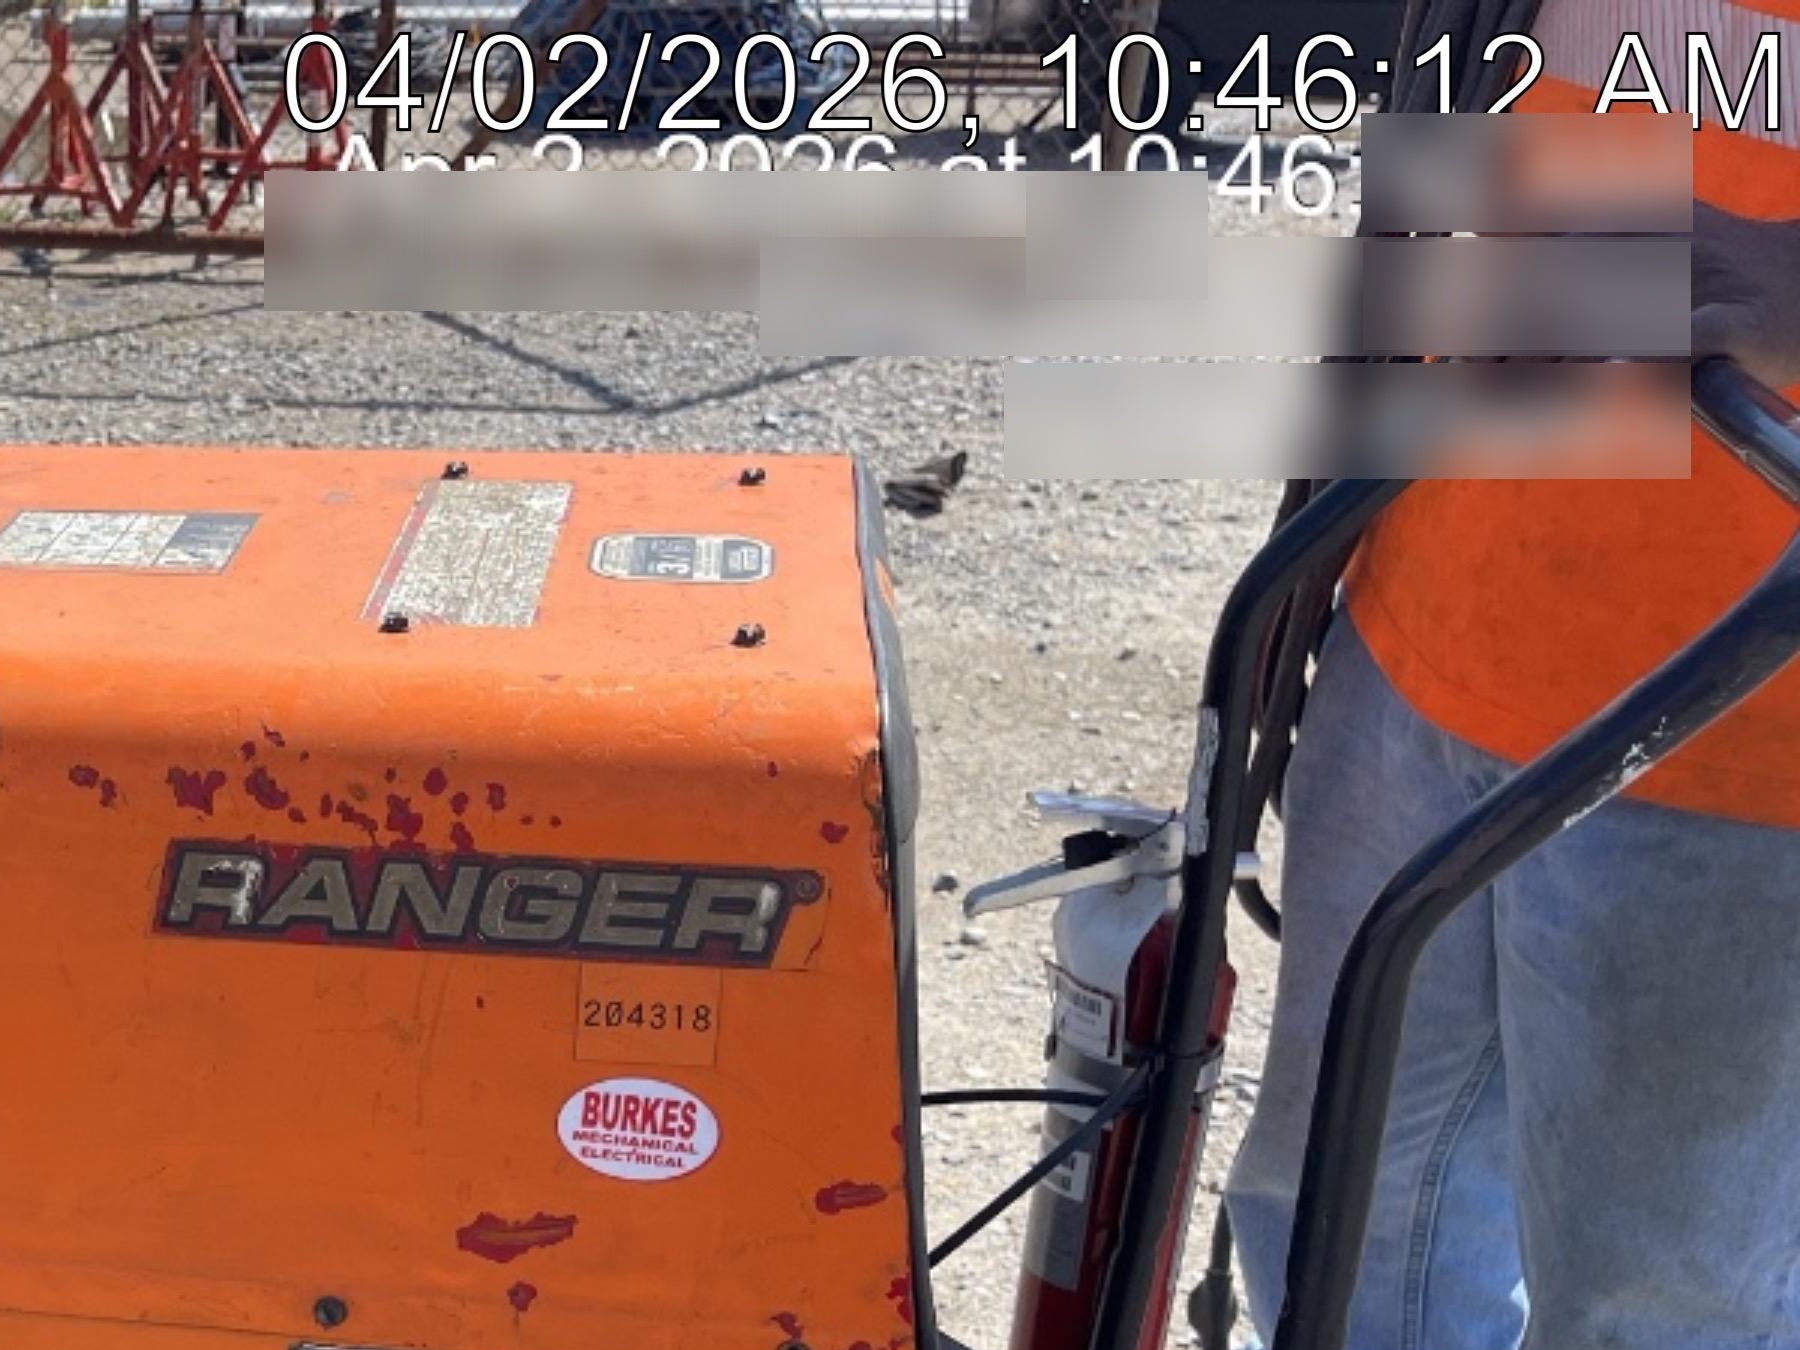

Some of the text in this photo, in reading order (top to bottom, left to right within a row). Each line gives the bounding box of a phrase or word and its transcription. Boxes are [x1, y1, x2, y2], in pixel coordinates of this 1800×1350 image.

[167, 850, 782, 952] RANGER
[584, 998, 711, 1032] 204318
[581, 1091, 697, 1138] BURKES
[572, 1130, 699, 1155] MECHANICAL
[580, 1146, 687, 1168] ELECTRICAL
